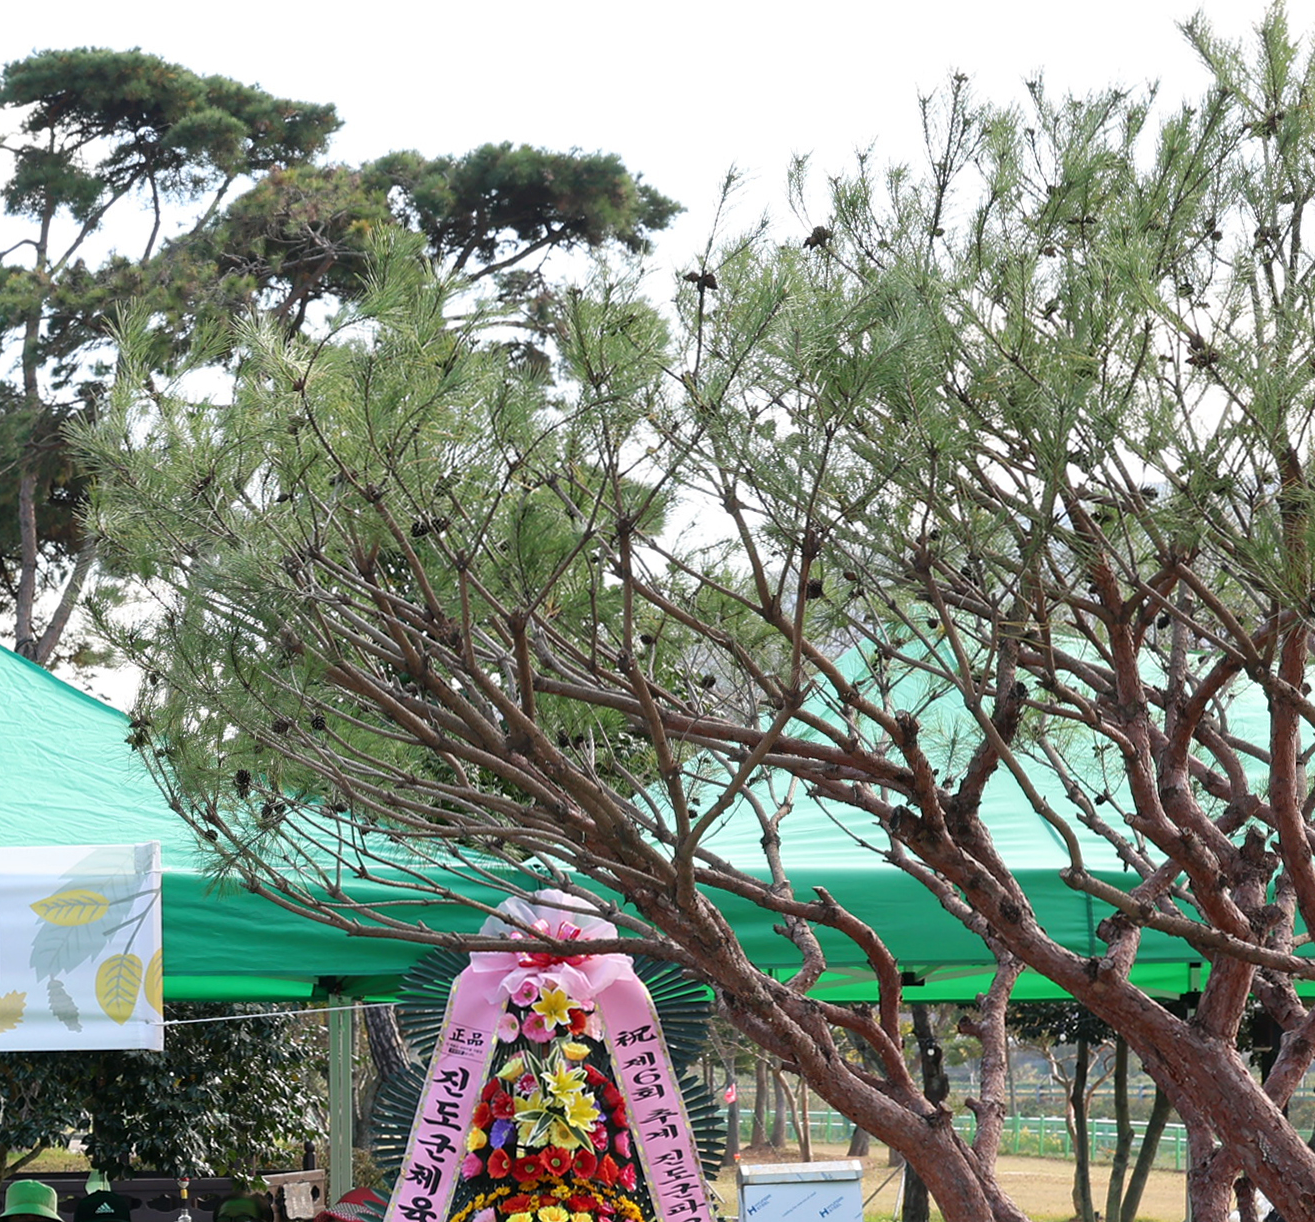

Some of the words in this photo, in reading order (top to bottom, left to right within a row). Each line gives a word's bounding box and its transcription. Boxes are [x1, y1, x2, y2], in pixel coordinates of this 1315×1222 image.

[448, 1027, 484, 1047] 正品
[614, 1024, 658, 1048] 祝
[621, 1051, 665, 1102] 제6회
[639, 1108, 679, 1142] 추계
